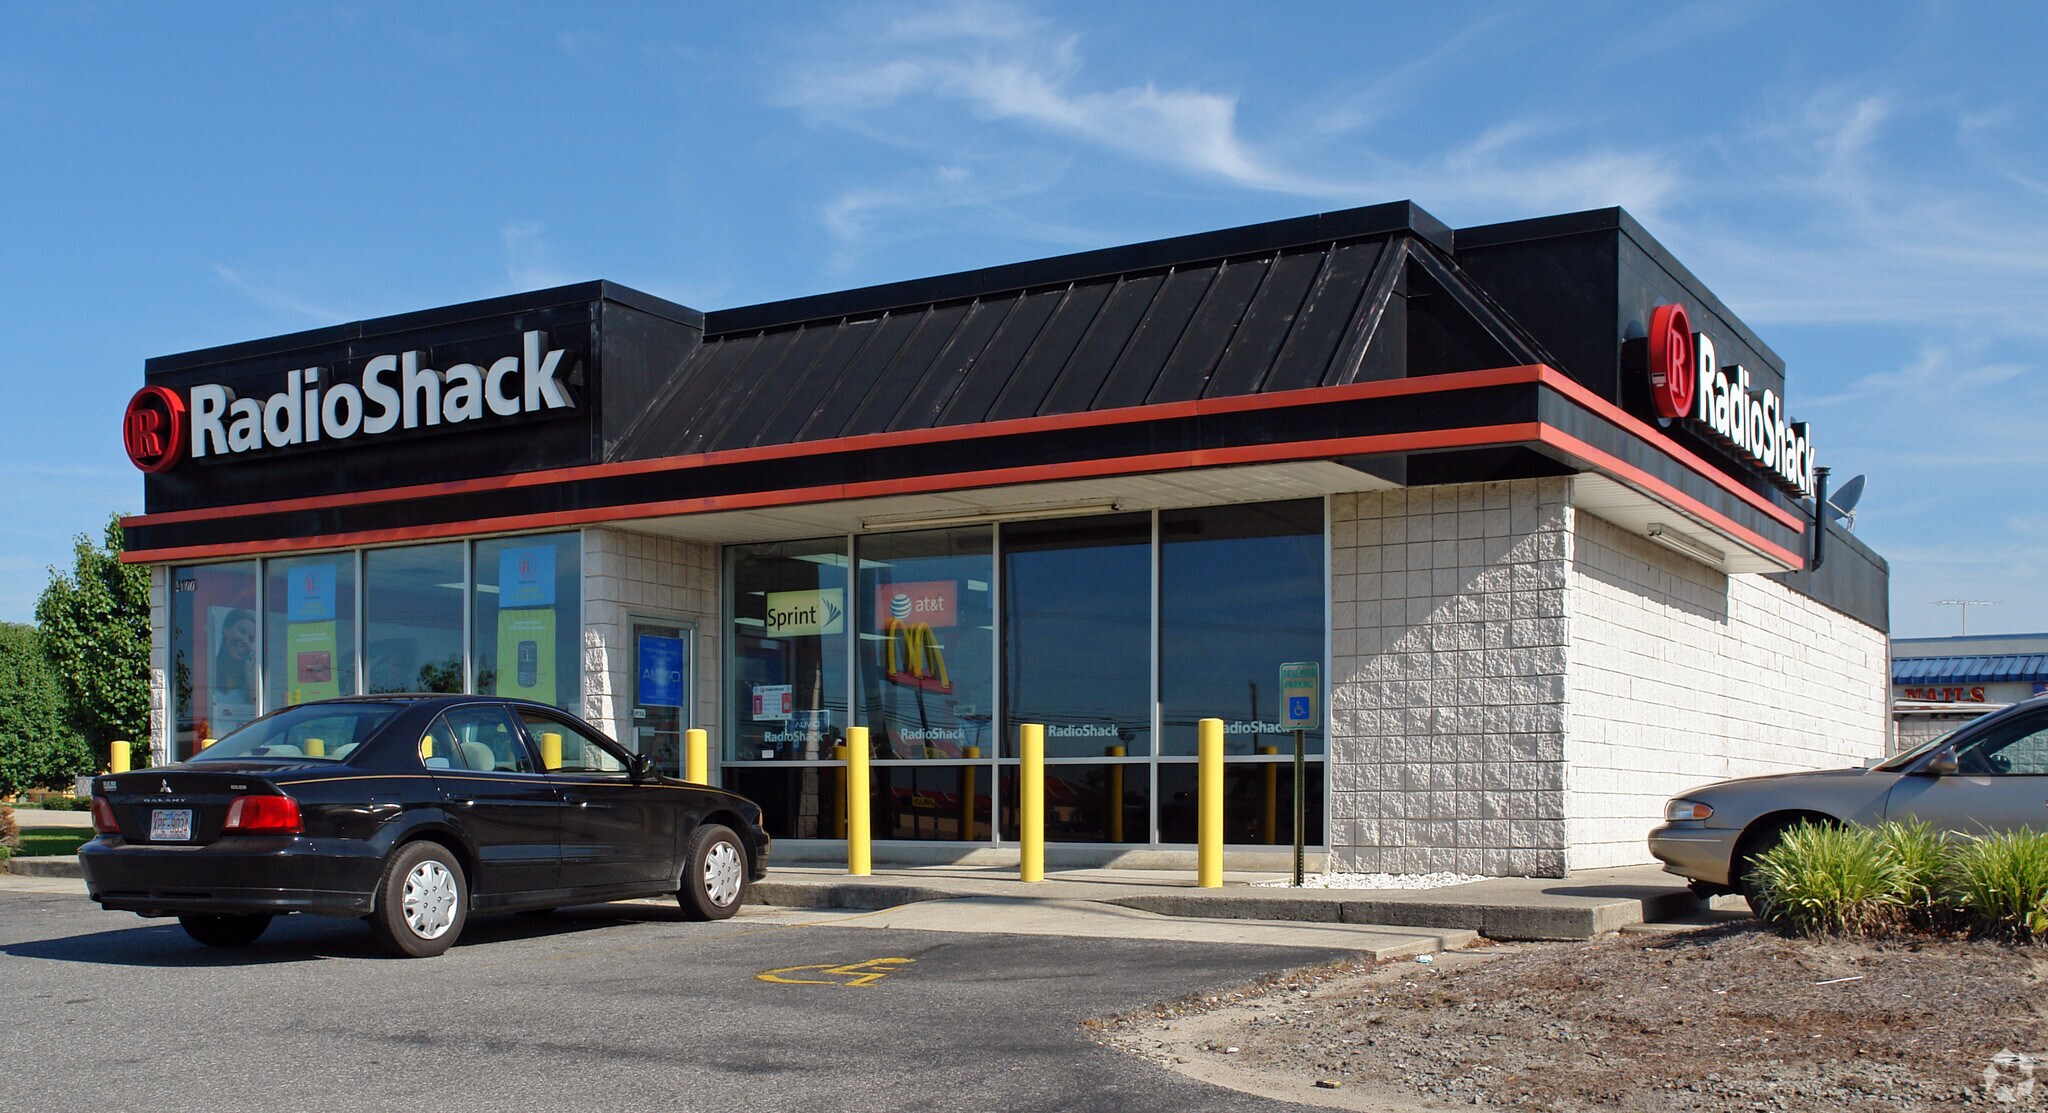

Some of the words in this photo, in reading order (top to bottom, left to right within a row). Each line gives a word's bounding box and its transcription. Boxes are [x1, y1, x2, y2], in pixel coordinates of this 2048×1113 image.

[190, 330, 574, 459] RadioShack
[1699, 332, 1816, 498] RadioShack
[914, 595, 945, 613] at&t
[767, 606, 817, 630] Sprint
[1285, 681, 1314, 689] PARKING
[1904, 686, 1986, 703] NAILS
[900, 727, 965, 740] RadioShack
[1048, 722, 1119, 738] RadioShack
[1223, 720, 1290, 734] adioShac
[764, 730, 824, 743] RadioShack
